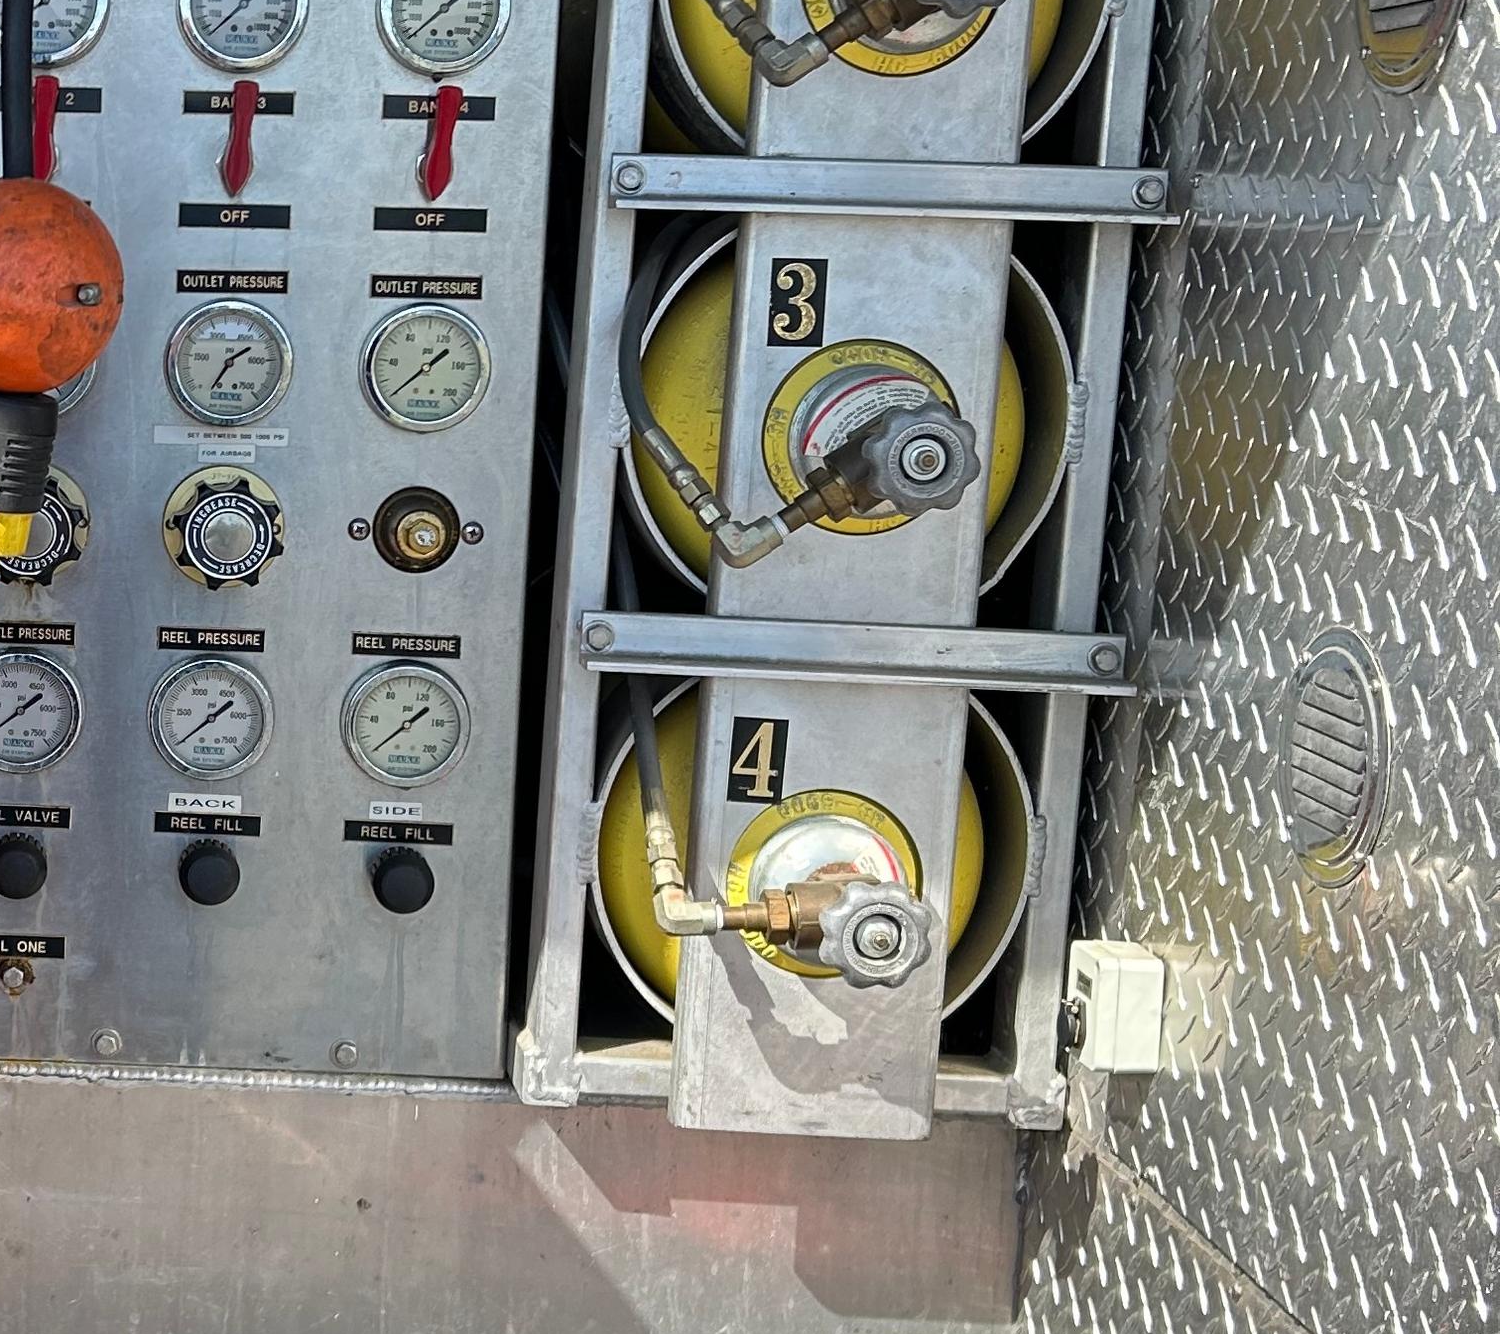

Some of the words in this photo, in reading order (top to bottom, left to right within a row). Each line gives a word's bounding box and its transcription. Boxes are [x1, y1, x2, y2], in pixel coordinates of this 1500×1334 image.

[65, 93, 74, 105] 2
[257, 97, 267, 109] 3
[460, 101, 469, 113] 4
[220, 210, 249, 223] OFF
[416, 213, 445, 227] OFF
[183, 275, 224, 288] OUTLET
[230, 275, 284, 289] PRESSURE
[375, 281, 417, 294] OUTLET
[422, 281, 479, 296] PRESSURE
[773, 263, 818, 339] 3
[436, 335, 450, 343] 120
[452, 362, 465, 370] 160
[192, 497, 238, 529] INCREASE
[219, 543, 265, 574] DECREASE
[18, 627, 71, 641] PRESSURE
[162, 632, 191, 644] REEL
[198, 632, 261, 646] PRESSURE
[356, 637, 385, 649] REEL
[392, 637, 456, 652] PRESSURE
[416, 694, 430, 702] 120
[432, 719, 444, 727] 160
[732, 722, 779, 797] 4
[175, 798, 235, 809] BACK
[16, 809, 60, 824] VALVE
[372, 805, 421, 816] SIDE
[170, 818, 206, 830] REEL
[214, 819, 242, 831] FILL
[361, 827, 396, 839] REEL
[405, 828, 434, 841] FILL
[17, 941, 46, 953] ONE
